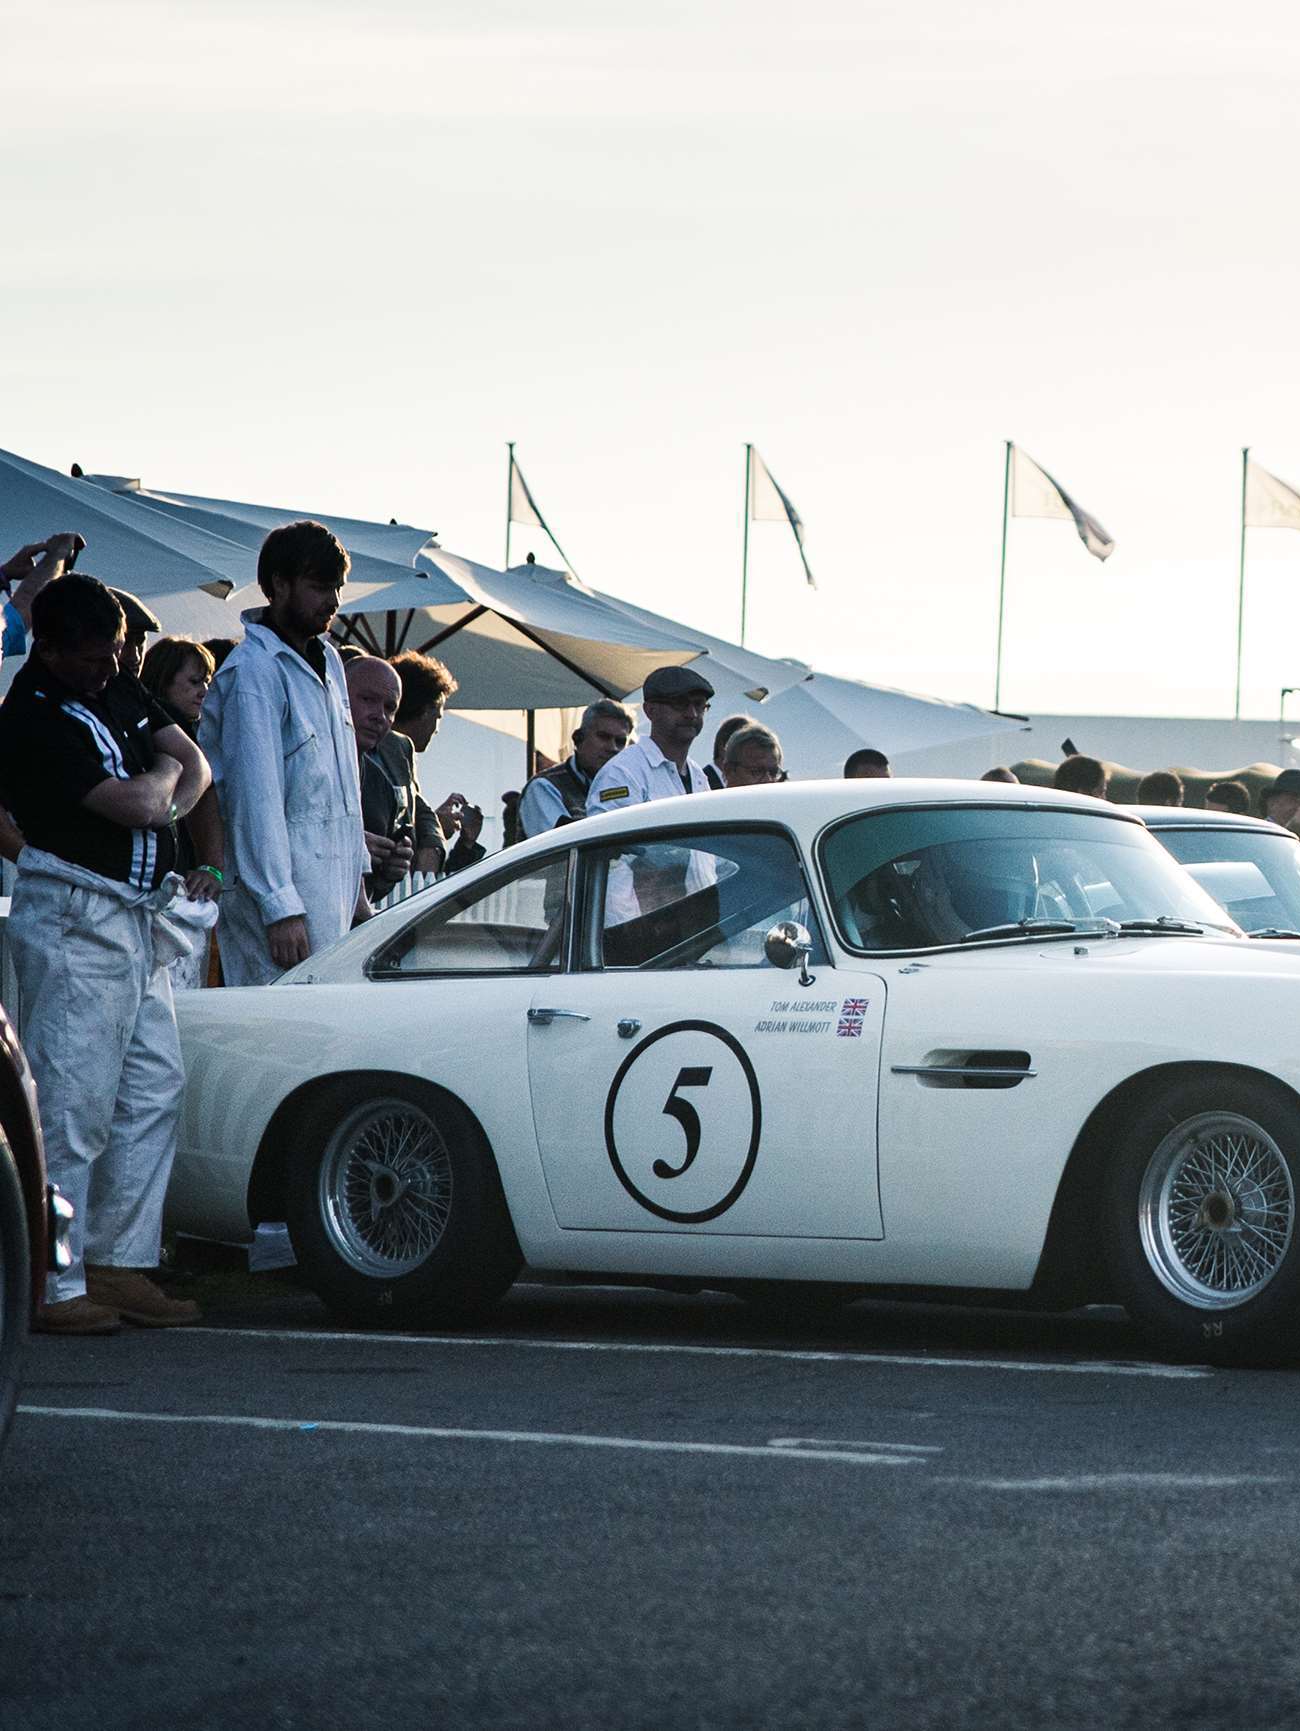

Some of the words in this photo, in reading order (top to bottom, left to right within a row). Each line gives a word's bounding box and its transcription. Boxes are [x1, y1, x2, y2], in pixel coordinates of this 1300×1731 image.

[769, 1001, 789, 1012] TOM
[789, 1001, 838, 1012] ALEXANDER
[754, 1021, 786, 1033] ADRIAN
[788, 1021, 832, 1033] WILLMOTT
[652, 1066, 713, 1179] 5
